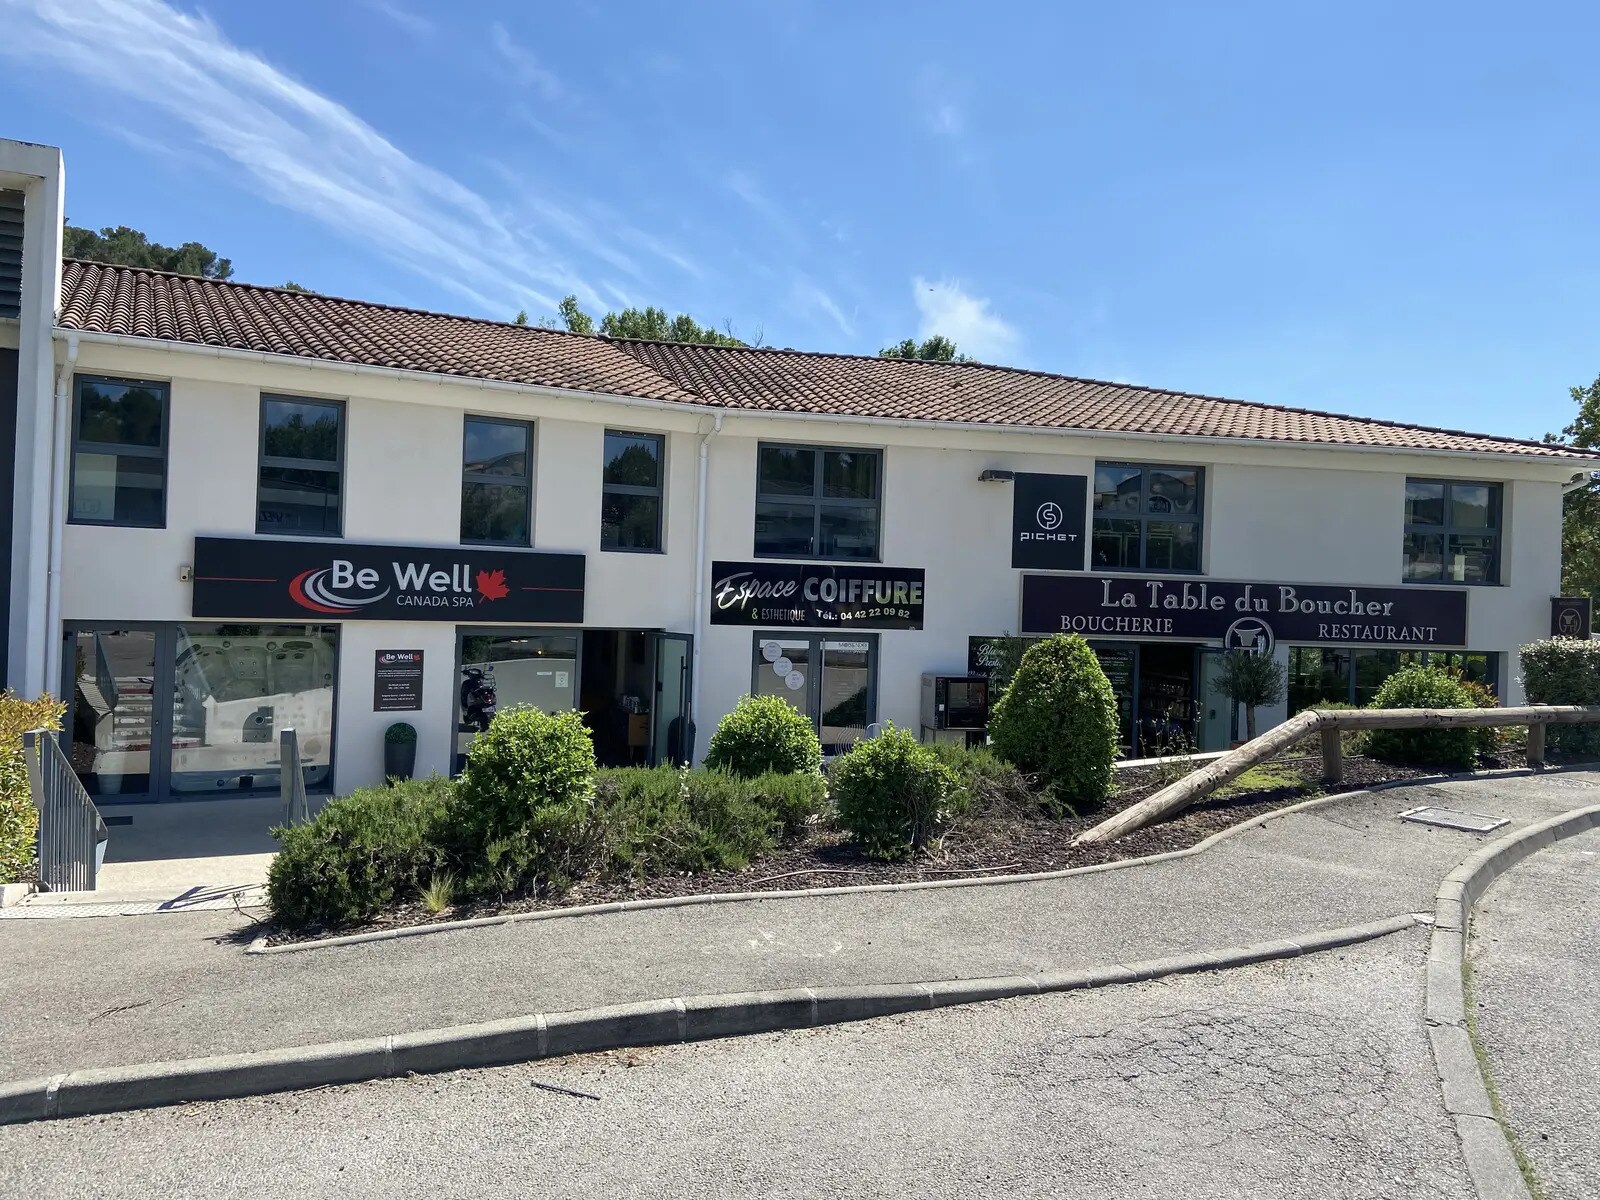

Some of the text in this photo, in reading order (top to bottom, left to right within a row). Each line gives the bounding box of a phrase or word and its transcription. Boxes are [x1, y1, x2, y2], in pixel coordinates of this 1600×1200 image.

[1020, 532, 1077, 541] PICHET
[332, 559, 472, 593] Be Well
[715, 571, 923, 611] Espace COIFFURE
[1101, 579, 1394, 616] La Table du Boucher
[396, 595, 474, 608] CANADA SPA
[751, 608, 805, 623] & ESTHETIQUE
[840, 611, 852, 620] 04
[854, 610, 867, 619] 42
[868, 608, 881, 617] 22
[883, 607, 896, 616] 09
[898, 609, 910, 618] 82
[1060, 615, 1173, 633] BOUCHERIE
[1318, 623, 1437, 642] RESTAURANT
